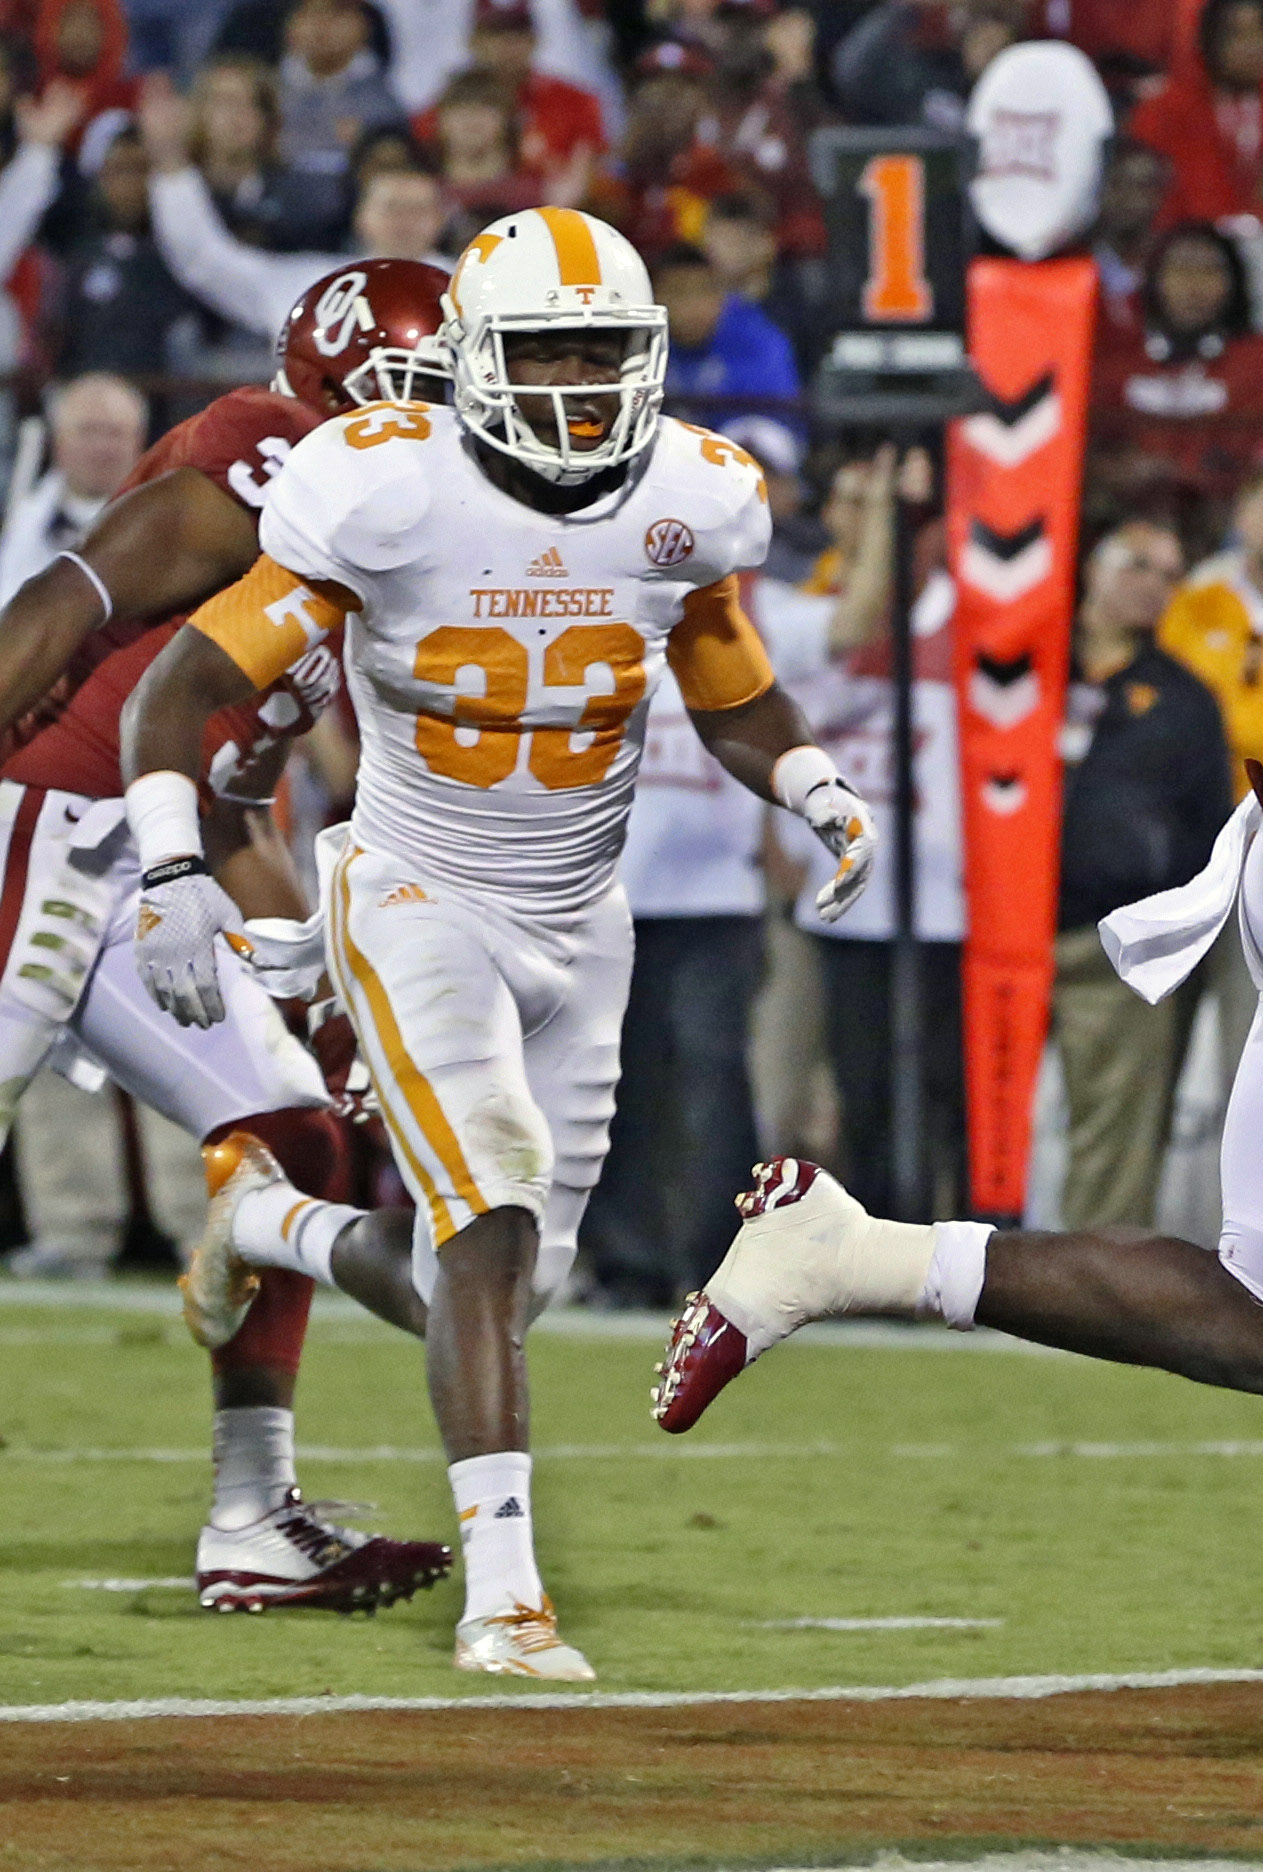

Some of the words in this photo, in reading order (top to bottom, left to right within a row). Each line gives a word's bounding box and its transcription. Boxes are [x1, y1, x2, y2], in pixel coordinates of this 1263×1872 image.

[857, 154, 934, 323] 1
[314, 271, 365, 357] OU
[576, 288, 596, 305] T
[648, 520, 691, 564] SEC
[263, 585, 329, 652] T
[470, 588, 614, 617] TENNESSEE
[412, 622, 646, 790] 33
